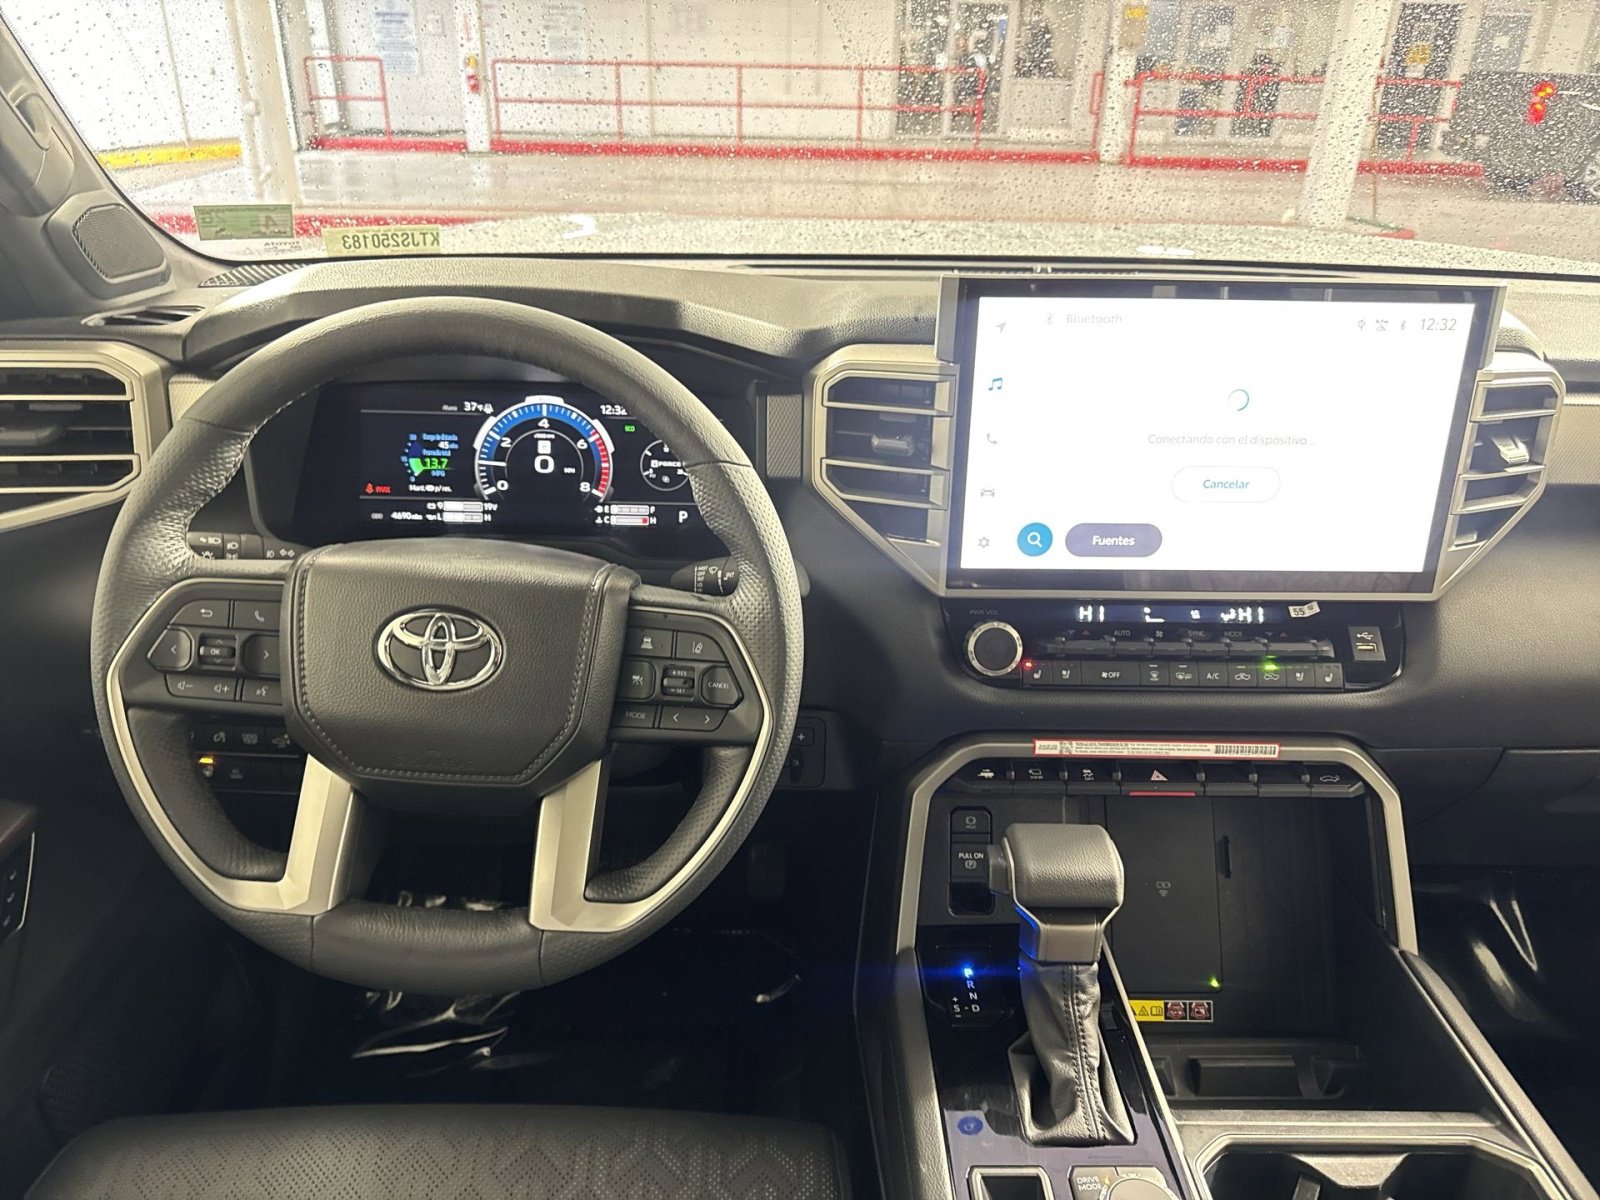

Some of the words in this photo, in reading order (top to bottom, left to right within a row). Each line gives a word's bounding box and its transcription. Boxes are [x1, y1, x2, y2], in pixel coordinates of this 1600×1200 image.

[1066, 312, 1122, 325] Bluetooth
[1420, 318, 1457, 331] 12:32
[537, 418, 550, 429] 4
[500, 437, 512, 448] 2
[576, 438, 588, 450] 6
[1148, 434, 1214, 445] Conectando
[1215, 436, 1235, 445] con
[1238, 434, 1249, 445] el
[424, 457, 448, 469] 13.7
[534, 454, 555, 474] 0
[496, 480, 509, 491] 0
[579, 481, 591, 492] 8
[1203, 479, 1250, 490] Cancelar
[678, 510, 689, 523] P
[1091, 535, 1136, 547] Fuentes
[1078, 605, 1105, 622] HI
[1237, 606, 1265, 624] HI
[1292, 607, 1305, 616] 55
[1113, 629, 1131, 637] AUTO
[1107, 671, 1121, 679] OFF
[1206, 671, 1220, 680] A/C
[707, 680, 729, 689] CANCEL
[625, 710, 647, 720] MODE
[966, 980, 975, 990] R
[968, 992, 978, 1001] N
[952, 1004, 961, 1013] S
[971, 1004, 981, 1013] D
[1076, 1175, 1101, 1185] DRIVE
